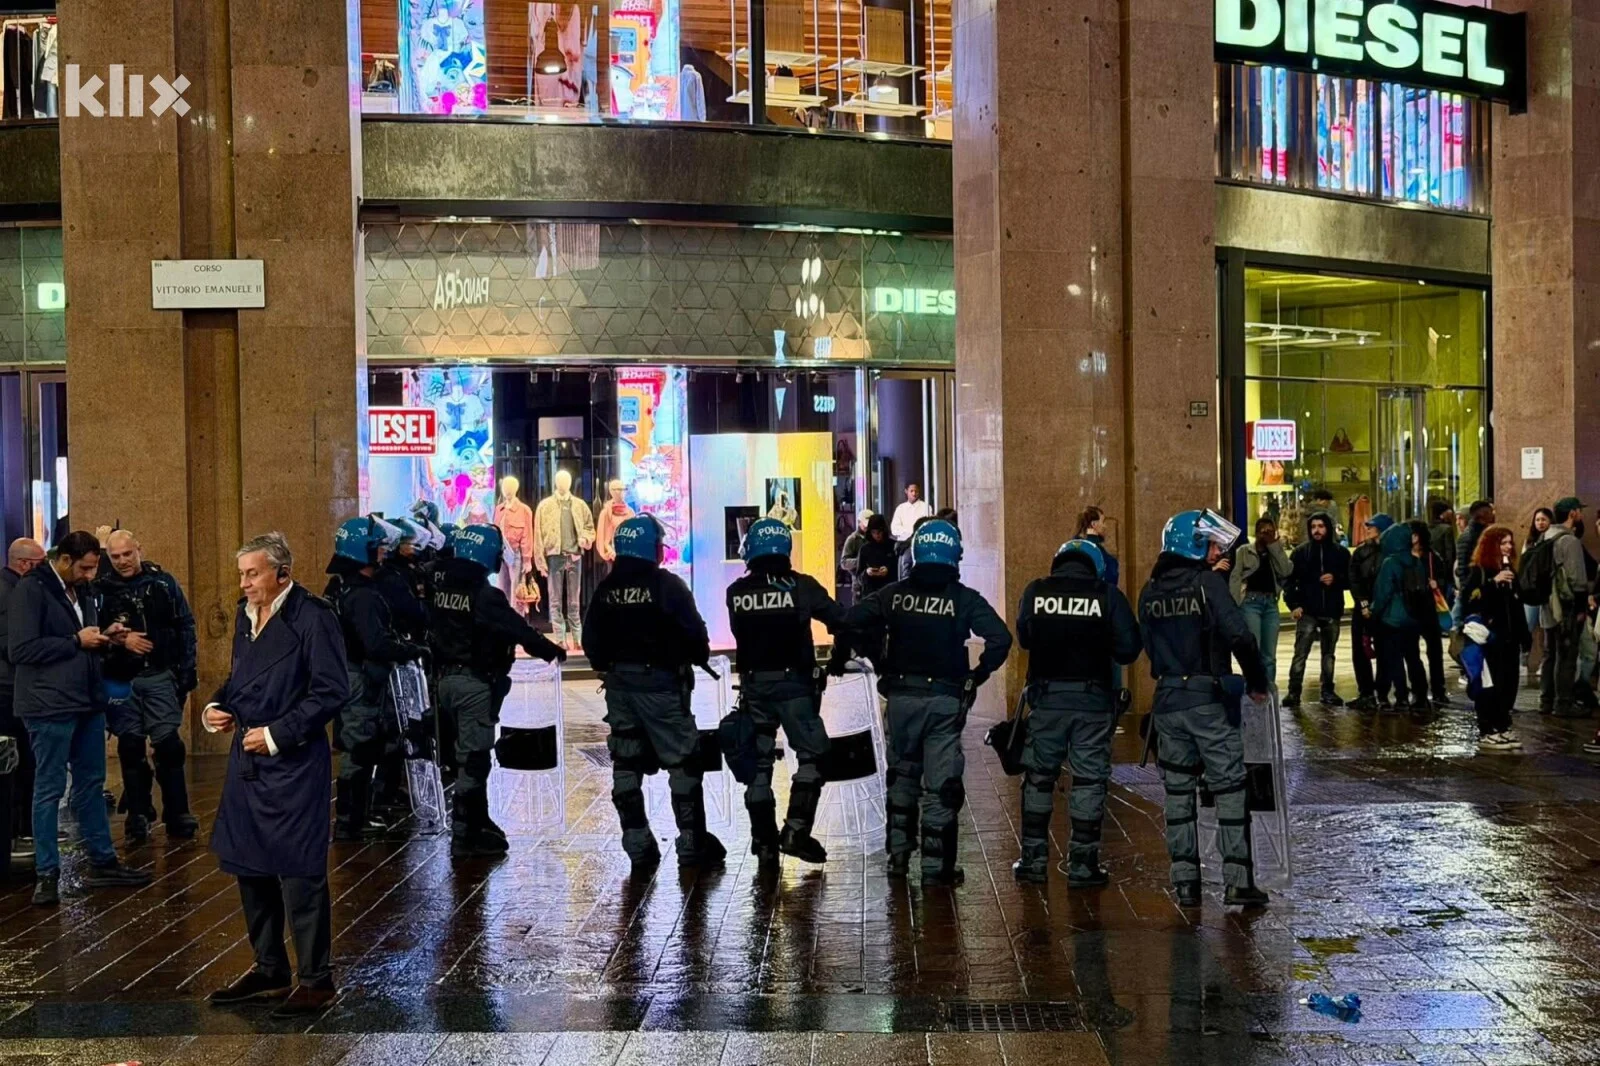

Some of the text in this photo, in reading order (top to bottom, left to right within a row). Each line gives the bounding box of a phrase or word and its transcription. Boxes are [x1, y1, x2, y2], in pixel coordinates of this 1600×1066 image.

[1216, 0, 1504, 86] DIESEL
[156, 285, 262, 294] VITTORIO EMANUELE II
[875, 287, 956, 315] DIES
[370, 414, 434, 444] IESEL
[1257, 427, 1293, 450] DIESEL
[918, 532, 954, 547] POLIZIA
[434, 592, 471, 612] POLIZIA
[733, 591, 795, 613] POLIZIA
[892, 594, 956, 617] POLIZIA
[1034, 597, 1102, 617] POLIZIA
[1145, 597, 1202, 618] POLIZIA
